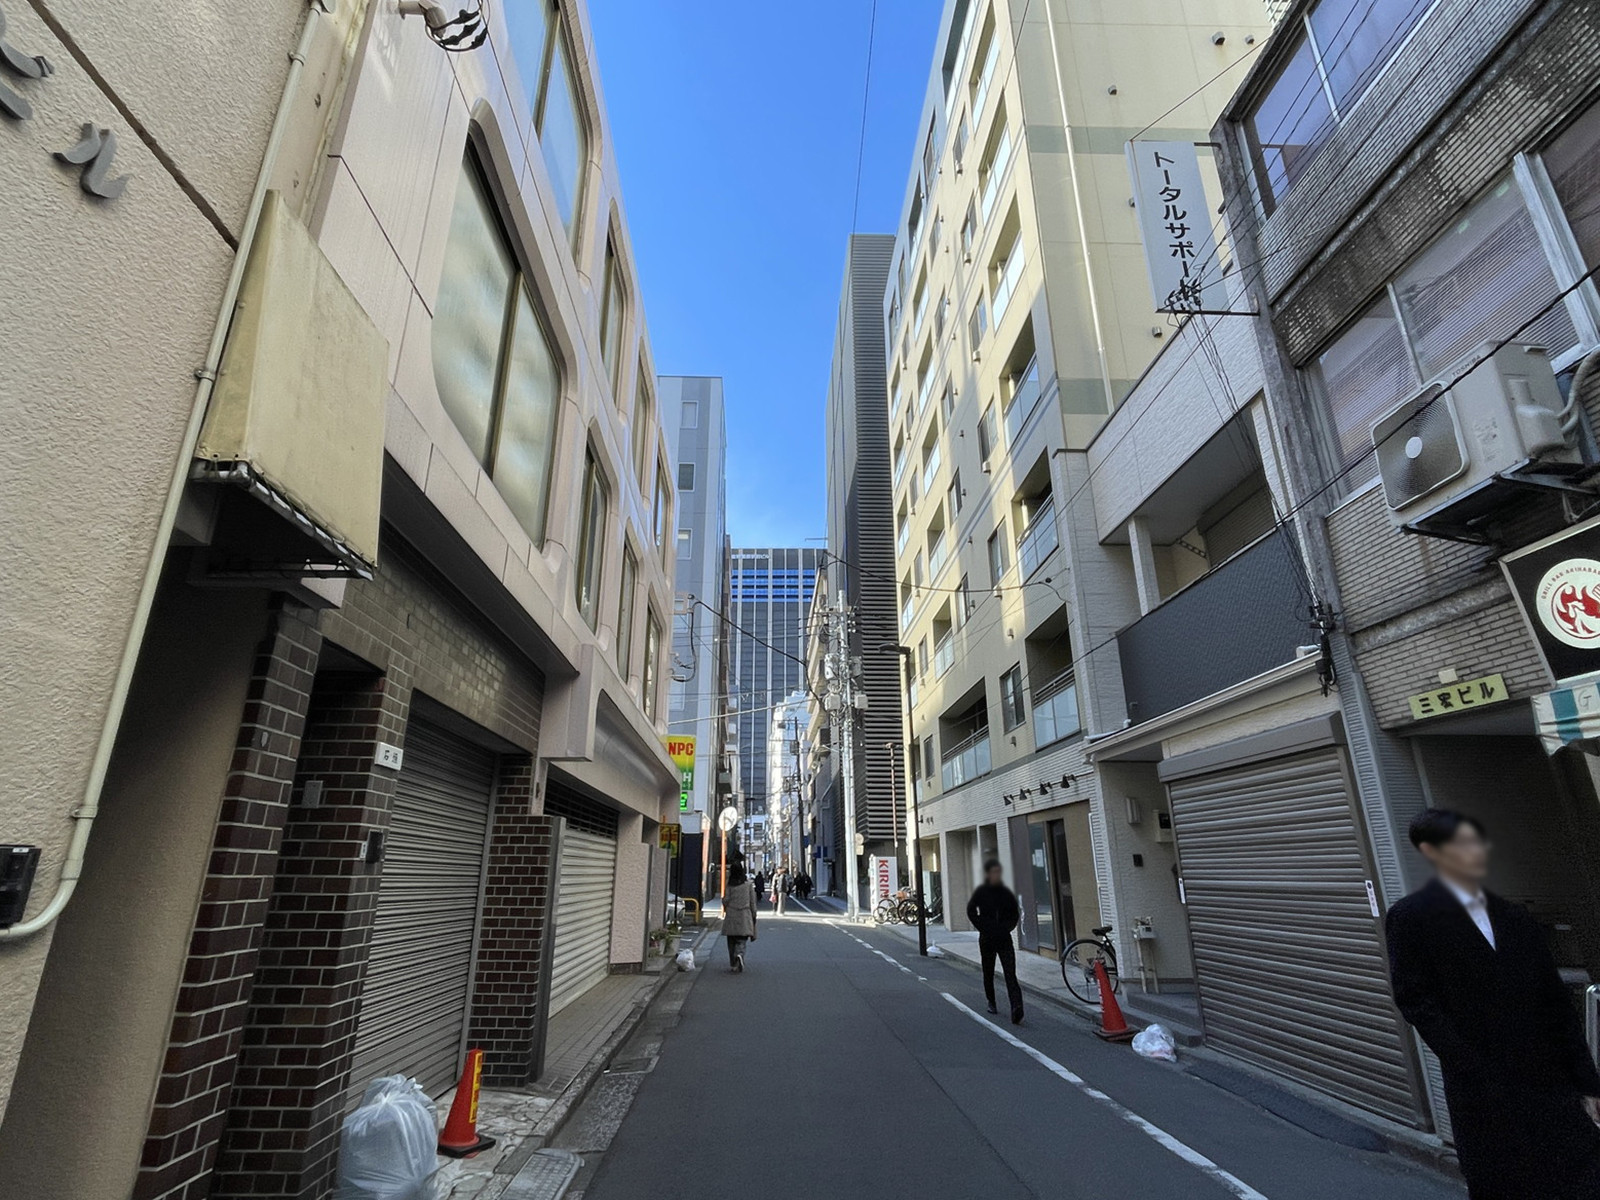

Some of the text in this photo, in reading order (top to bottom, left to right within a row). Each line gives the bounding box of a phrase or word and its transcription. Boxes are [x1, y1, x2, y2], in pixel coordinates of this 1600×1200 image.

[1452, 354, 1482, 377] TOSHIBA
[668, 742, 694, 756] NPC
[878, 859, 890, 899] KIRIN
